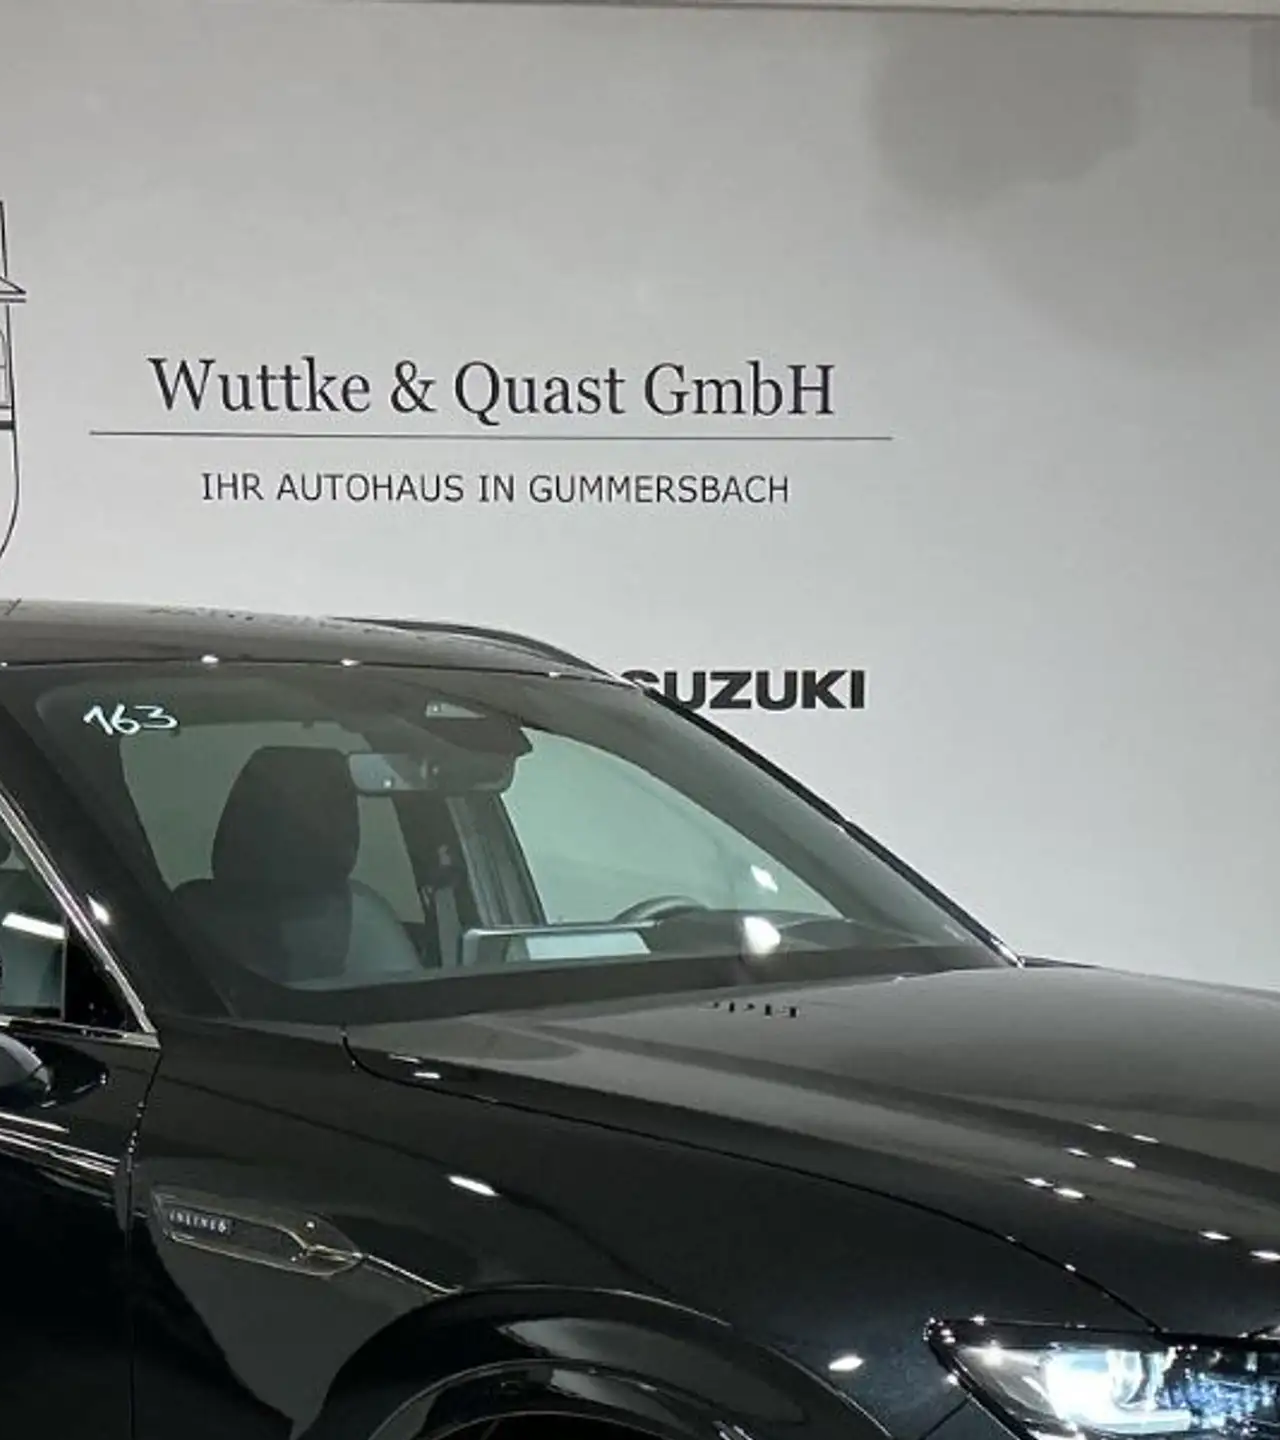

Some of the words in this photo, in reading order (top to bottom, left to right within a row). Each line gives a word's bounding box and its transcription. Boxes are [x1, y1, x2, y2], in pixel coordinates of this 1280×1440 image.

[147, 355, 371, 413] Wuttke
[390, 359, 437, 414] &
[455, 360, 626, 426] Quast
[644, 360, 835, 416] GmbH
[202, 472, 264, 500] IHR
[276, 473, 464, 502] AUTOHAUS
[479, 475, 514, 503] IN
[529, 475, 789, 504] GUMMERSBACH
[83, 703, 178, 735] 163
